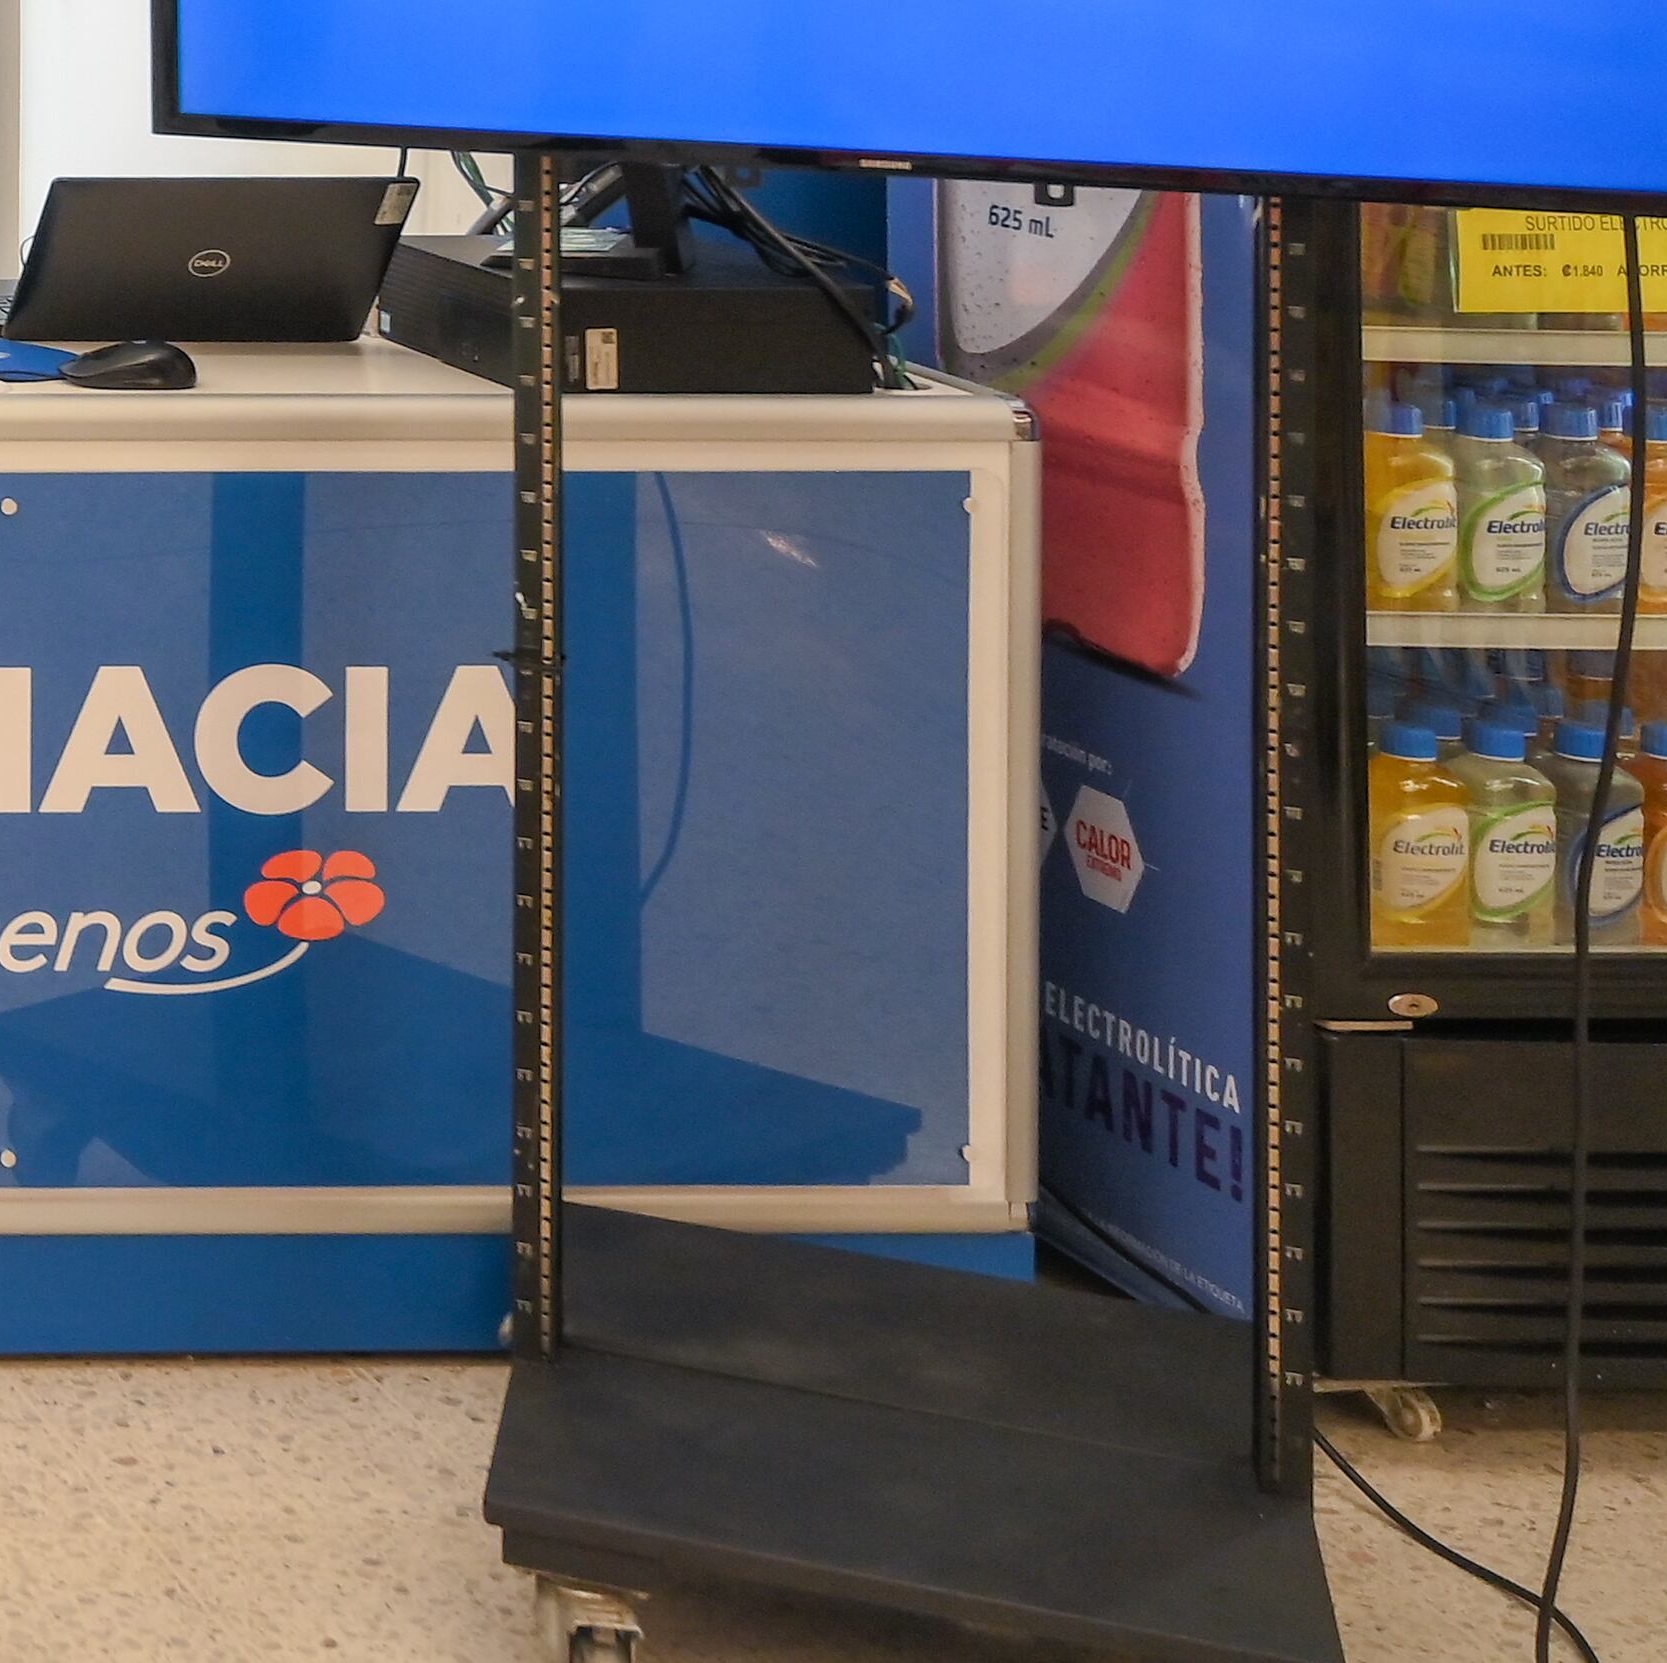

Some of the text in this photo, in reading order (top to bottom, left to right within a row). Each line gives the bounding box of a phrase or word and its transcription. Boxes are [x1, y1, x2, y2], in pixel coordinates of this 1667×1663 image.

[988, 204, 1055, 238] 625 mL
[1525, 215, 1595, 231] SURTIDO
[193, 255, 226, 270] DELL
[1492, 265, 1547, 277] ANTES:
[1075, 819, 1132, 870] CALOR
[1044, 980, 1241, 1115] ELECTROLÍTICA
